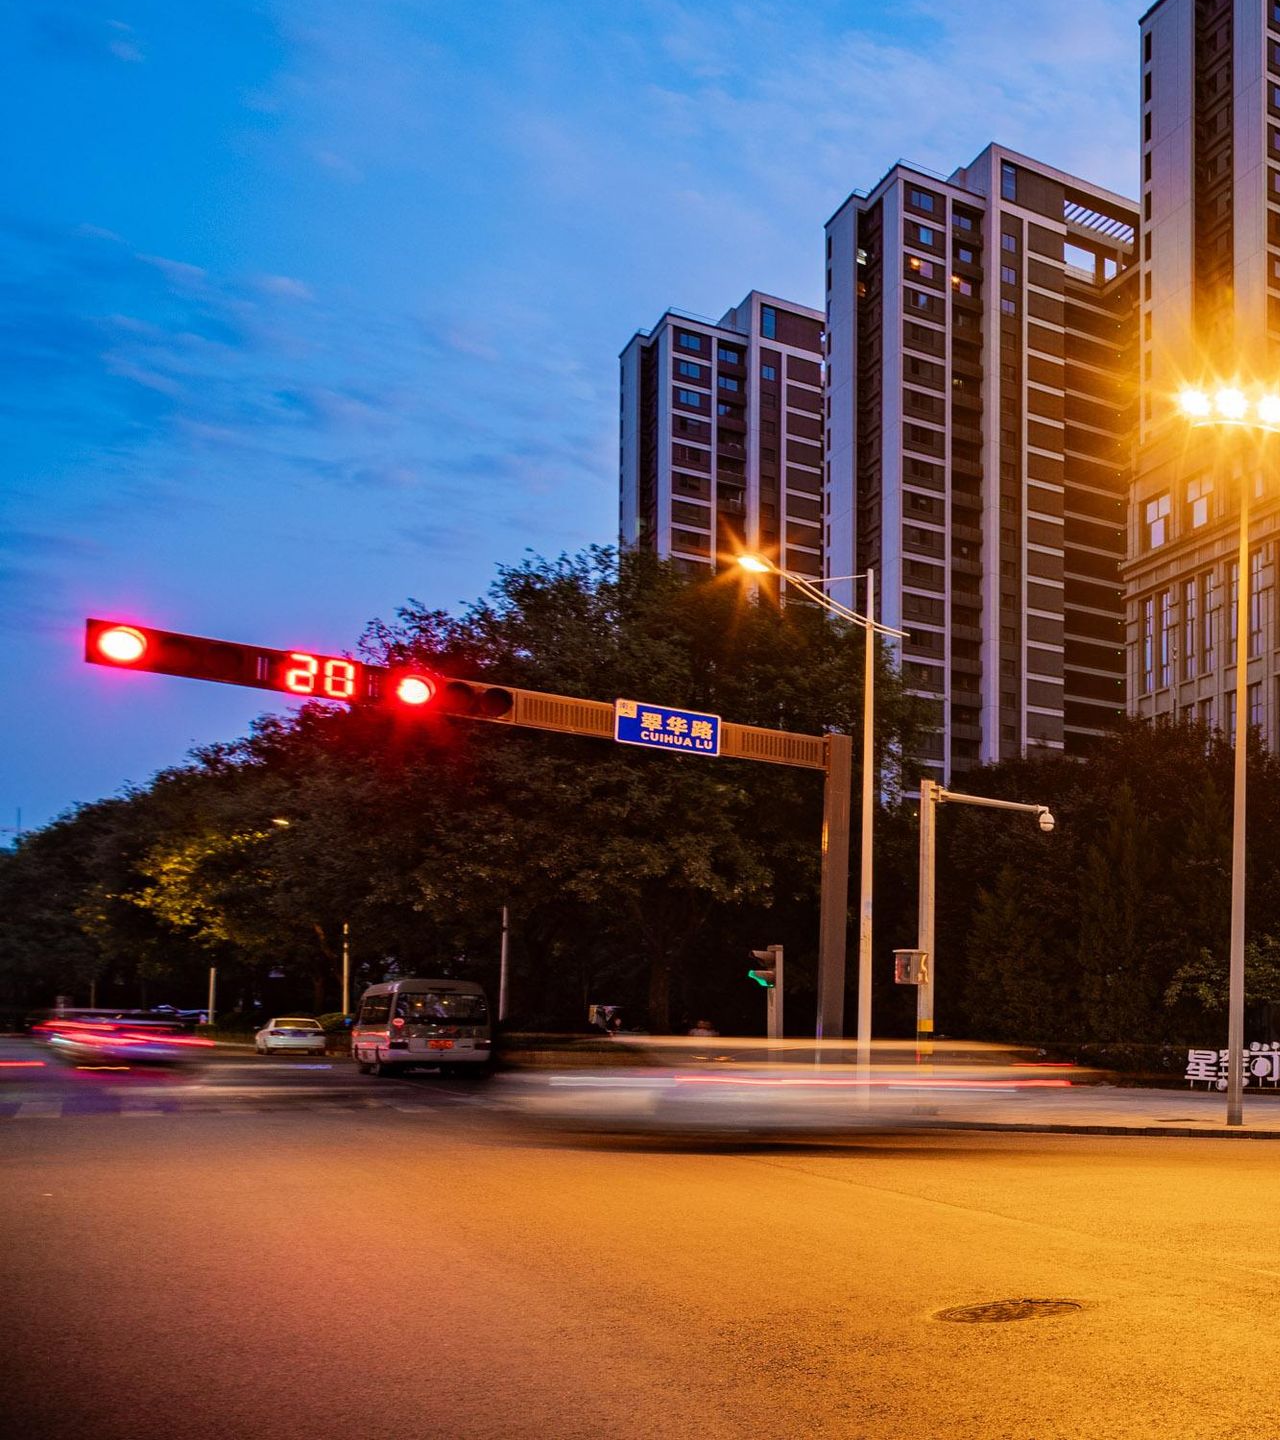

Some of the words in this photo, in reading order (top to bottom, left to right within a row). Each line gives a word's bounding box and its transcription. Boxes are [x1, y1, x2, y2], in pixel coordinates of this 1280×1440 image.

[640, 711, 714, 740] 翠华路
[640, 731, 693, 747] CUIHUA
[695, 740, 713, 750] LU
